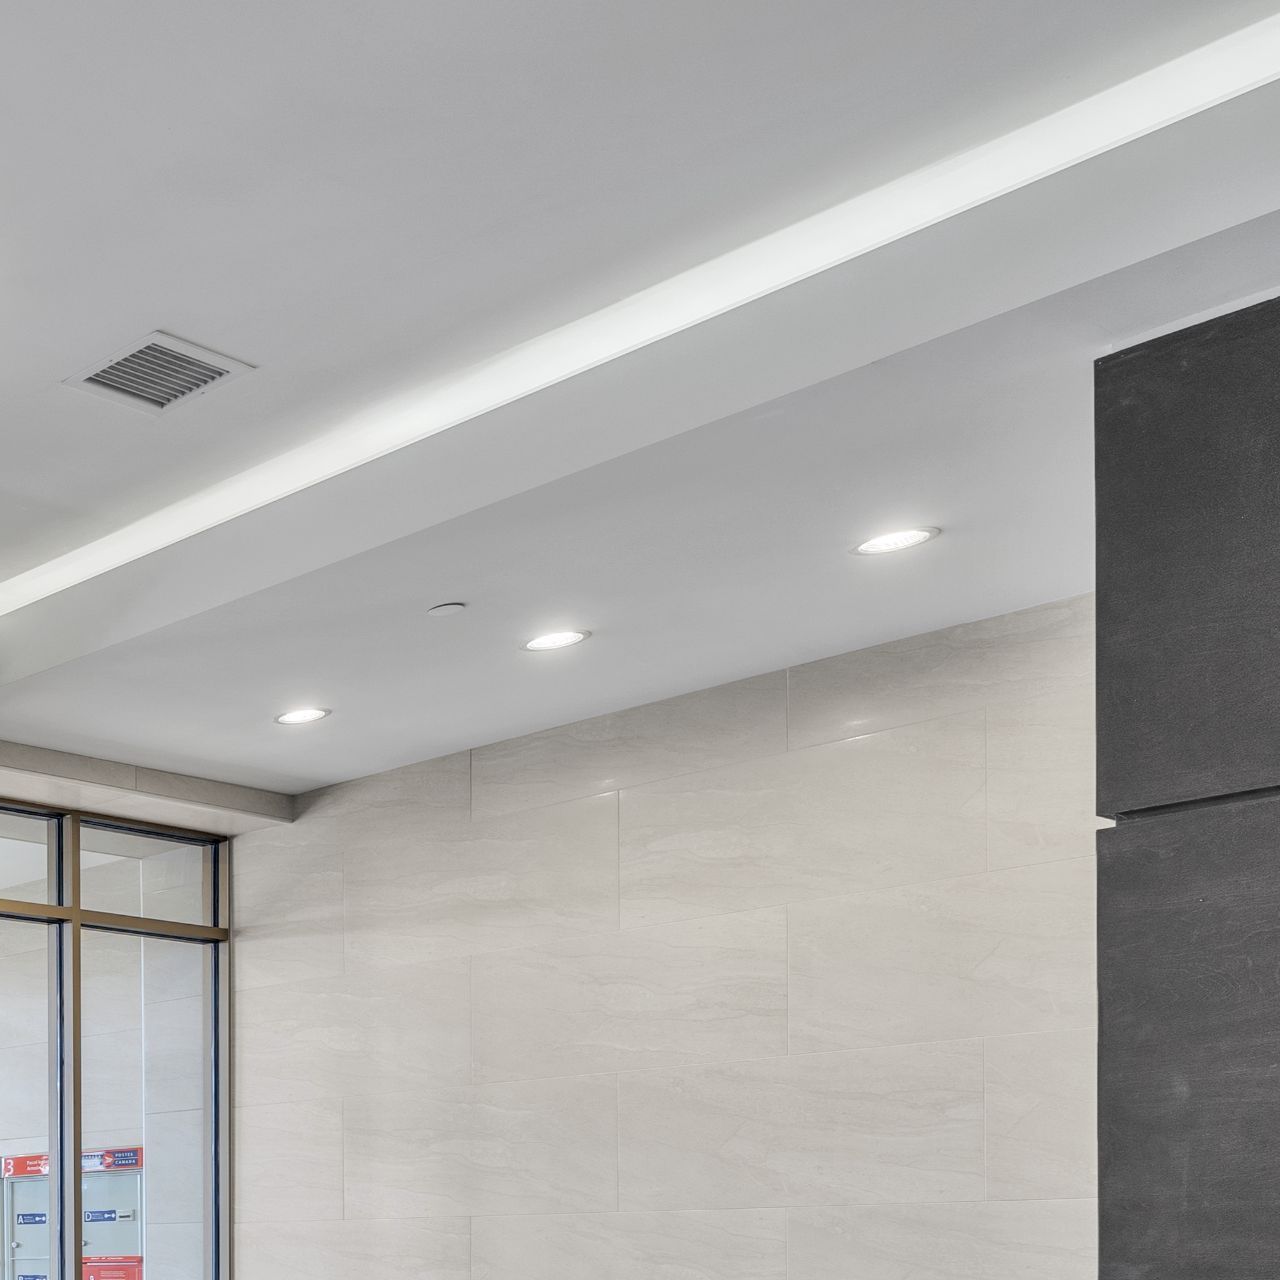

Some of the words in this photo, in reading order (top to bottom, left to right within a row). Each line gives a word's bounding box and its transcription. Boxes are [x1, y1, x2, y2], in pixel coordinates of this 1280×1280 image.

[6, 1159, 14, 1175] 3
[17, 1215, 24, 1224] A
[85, 1211, 92, 1222] D
